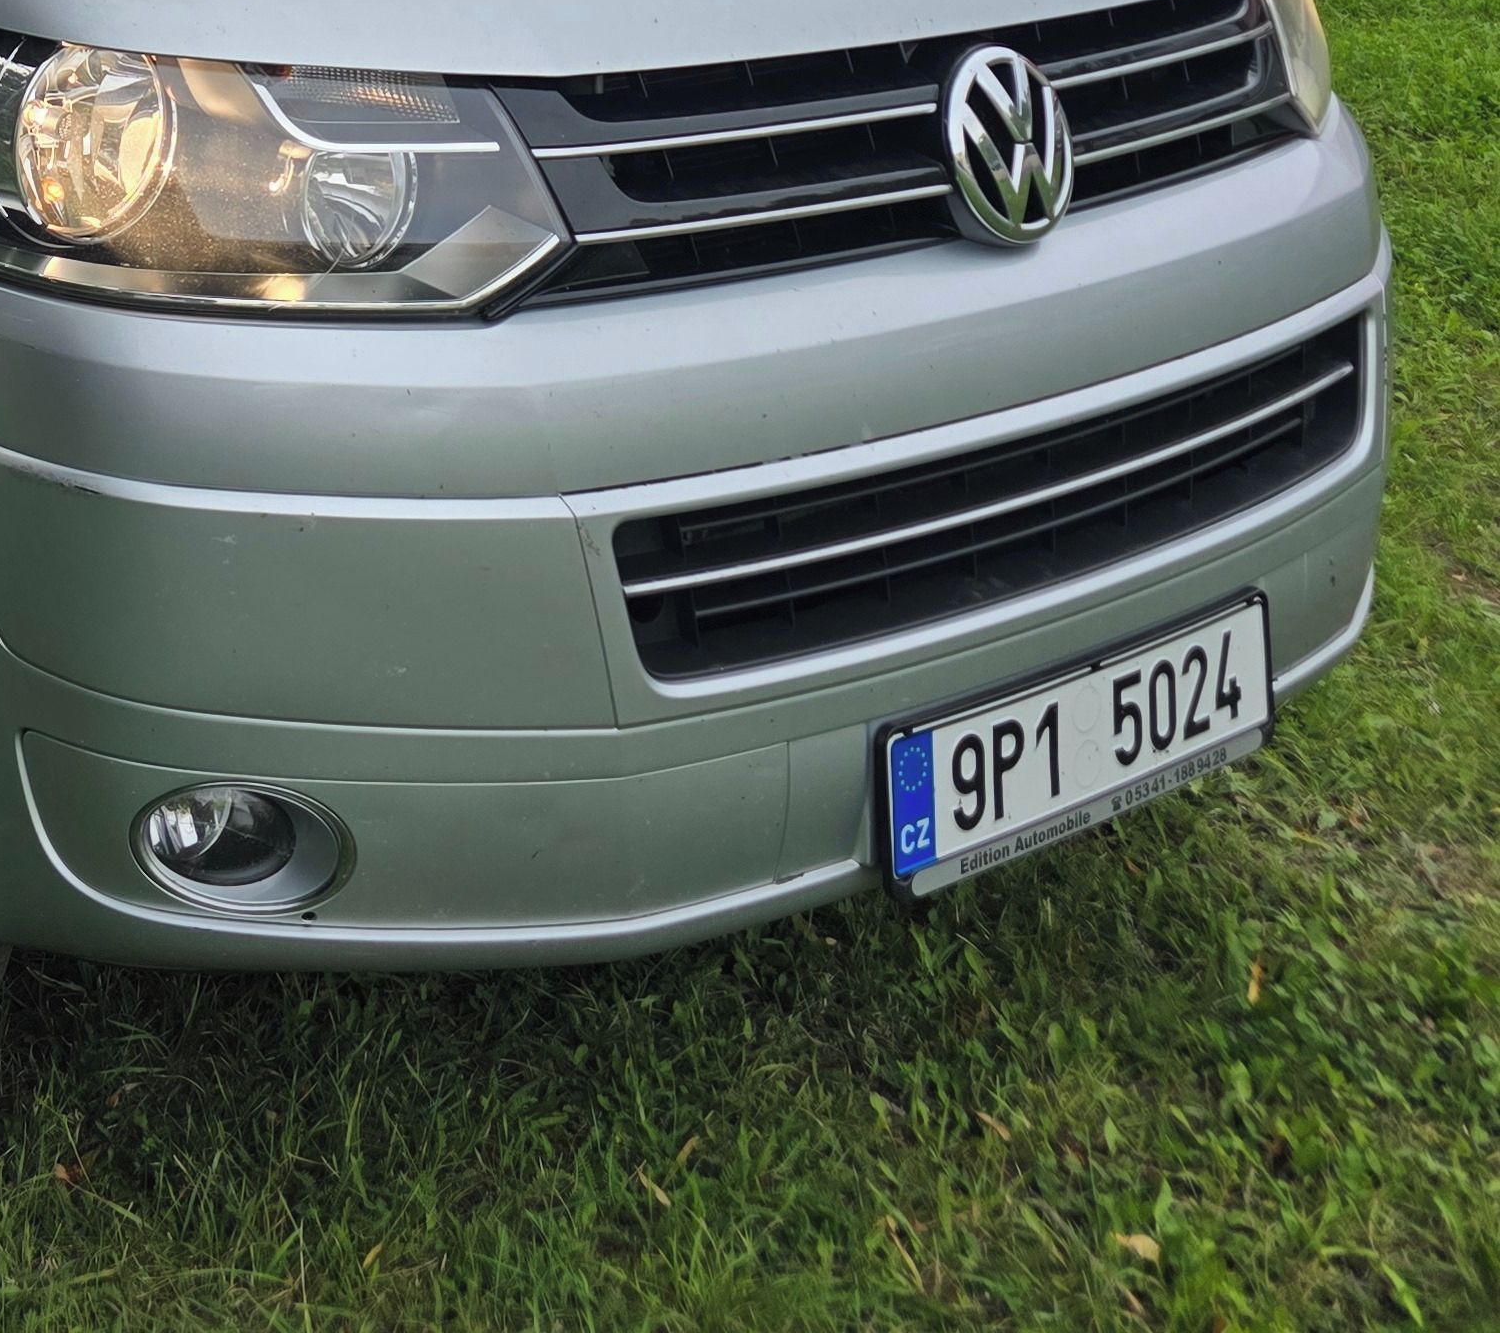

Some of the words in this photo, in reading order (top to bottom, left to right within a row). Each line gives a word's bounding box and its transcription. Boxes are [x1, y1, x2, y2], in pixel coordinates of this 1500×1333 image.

[951, 700, 1061, 832] 9P1
[1111, 629, 1242, 767] 5024
[899, 816, 931, 856] CZ
[959, 844, 1011, 876] Edition
[1014, 810, 1092, 854] Automobile
